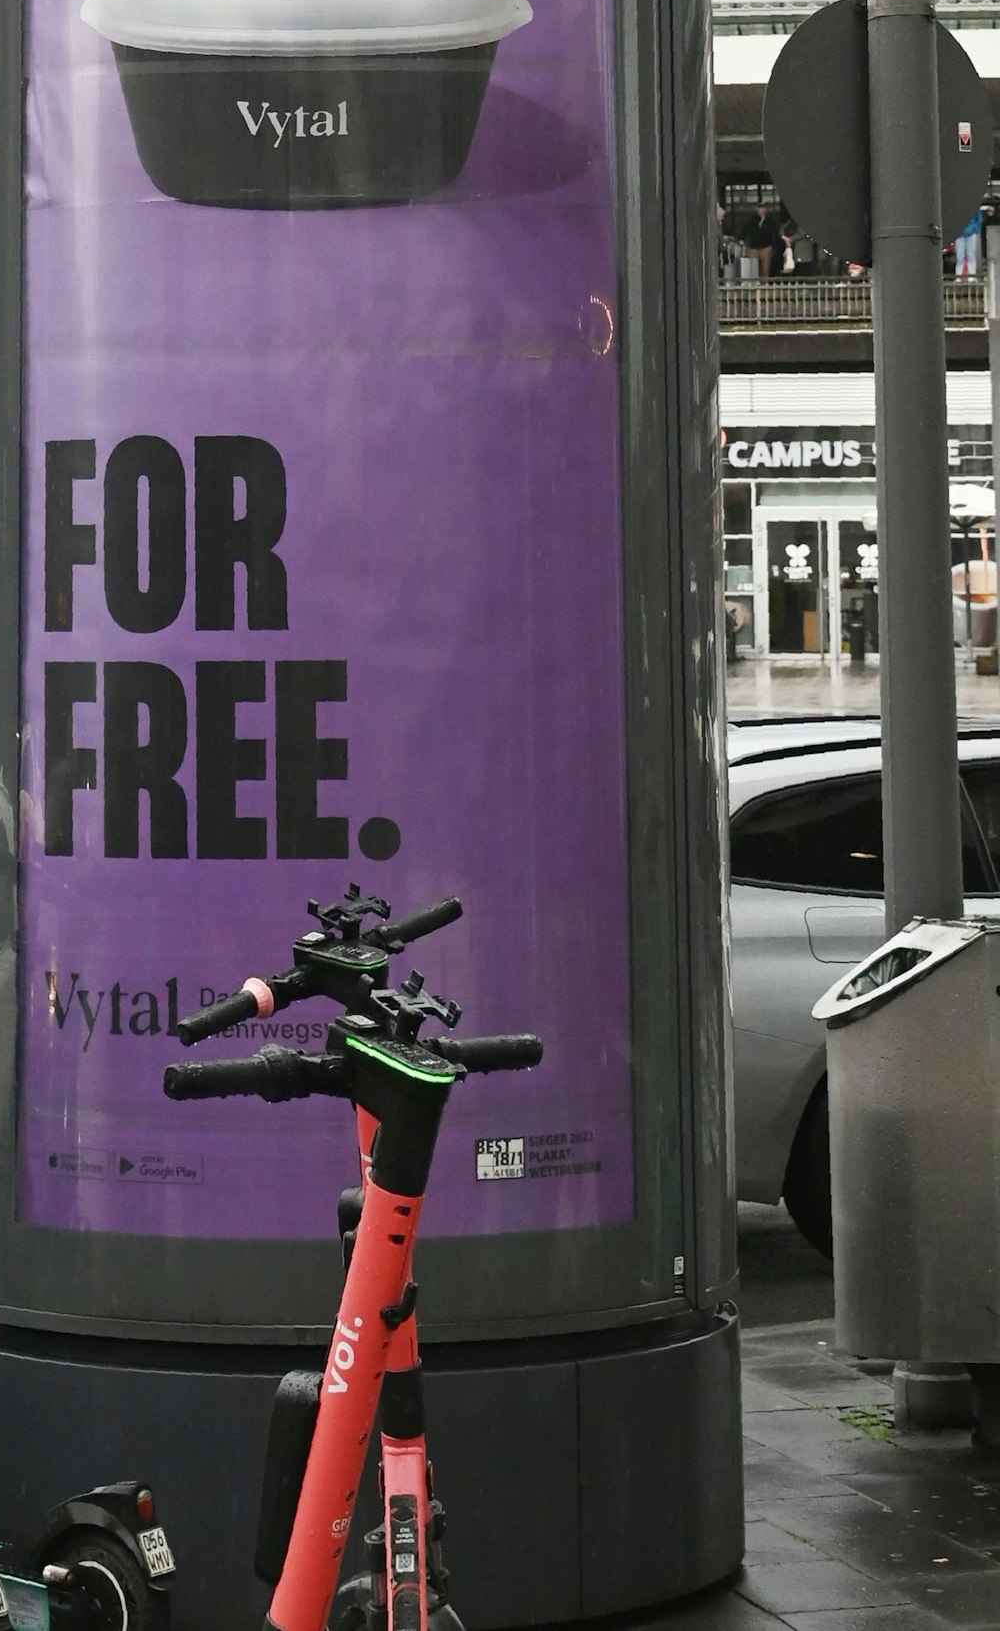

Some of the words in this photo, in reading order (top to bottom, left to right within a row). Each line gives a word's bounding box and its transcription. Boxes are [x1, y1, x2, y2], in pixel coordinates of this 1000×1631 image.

[237, 100, 349, 149] Vytal
[728, 441, 861, 468] CAMPUS
[45, 435, 289, 634] FOR
[45, 660, 401, 861] FREE.
[45, 971, 180, 1052] Vytal
[476, 1139, 510, 1154] BEST
[528, 1133, 568, 1147] SIEGER
[139, 1164, 175, 1180] Google
[176, 1166, 198, 1181] Play
[493, 1152, 524, 1167] 18/1
[327, 1316, 364, 1394] voi.
[143, 1530, 164, 1552] 056
